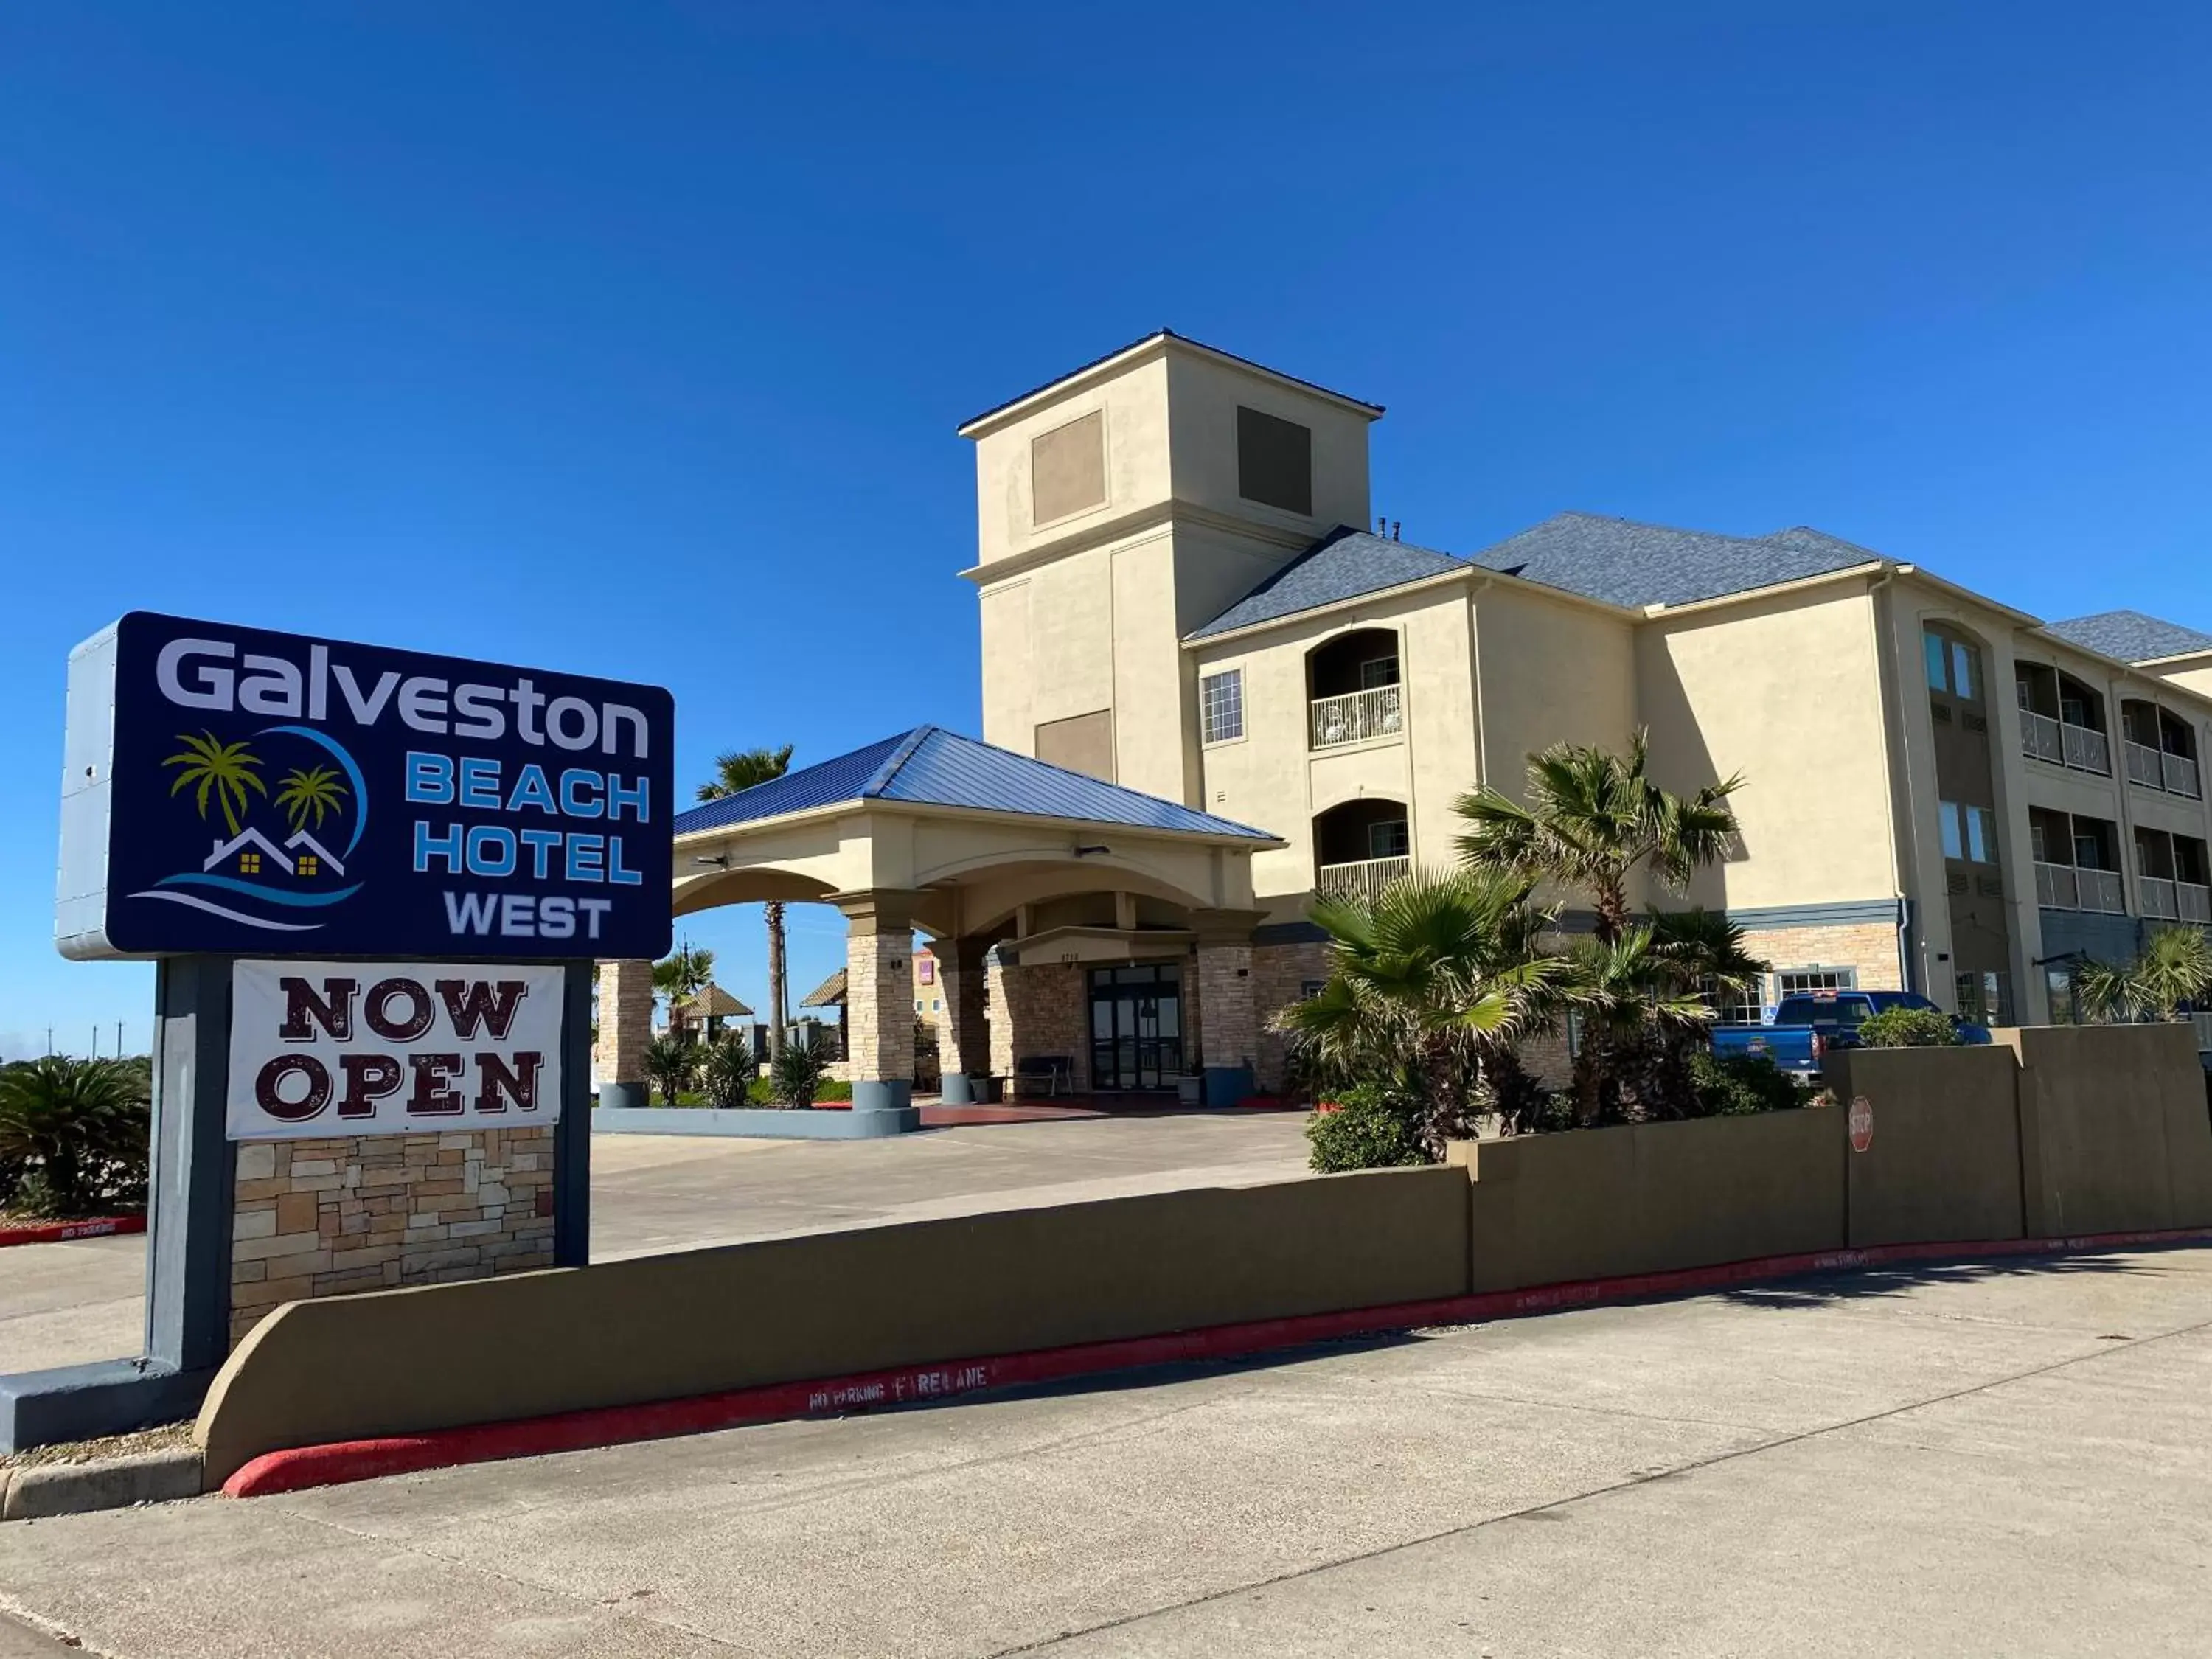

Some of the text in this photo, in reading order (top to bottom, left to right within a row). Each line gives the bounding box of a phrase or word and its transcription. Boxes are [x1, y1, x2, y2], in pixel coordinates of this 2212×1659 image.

[156, 638, 650, 759] Galveston
[405, 751, 650, 824] BEACH
[412, 821, 644, 886] HOTEL
[444, 891, 613, 939] WEST
[279, 978, 528, 1042] NOW
[255, 1051, 545, 1121] OPEN
[809, 1392, 828, 1410] NO
[833, 1382, 885, 1405] PARKING
